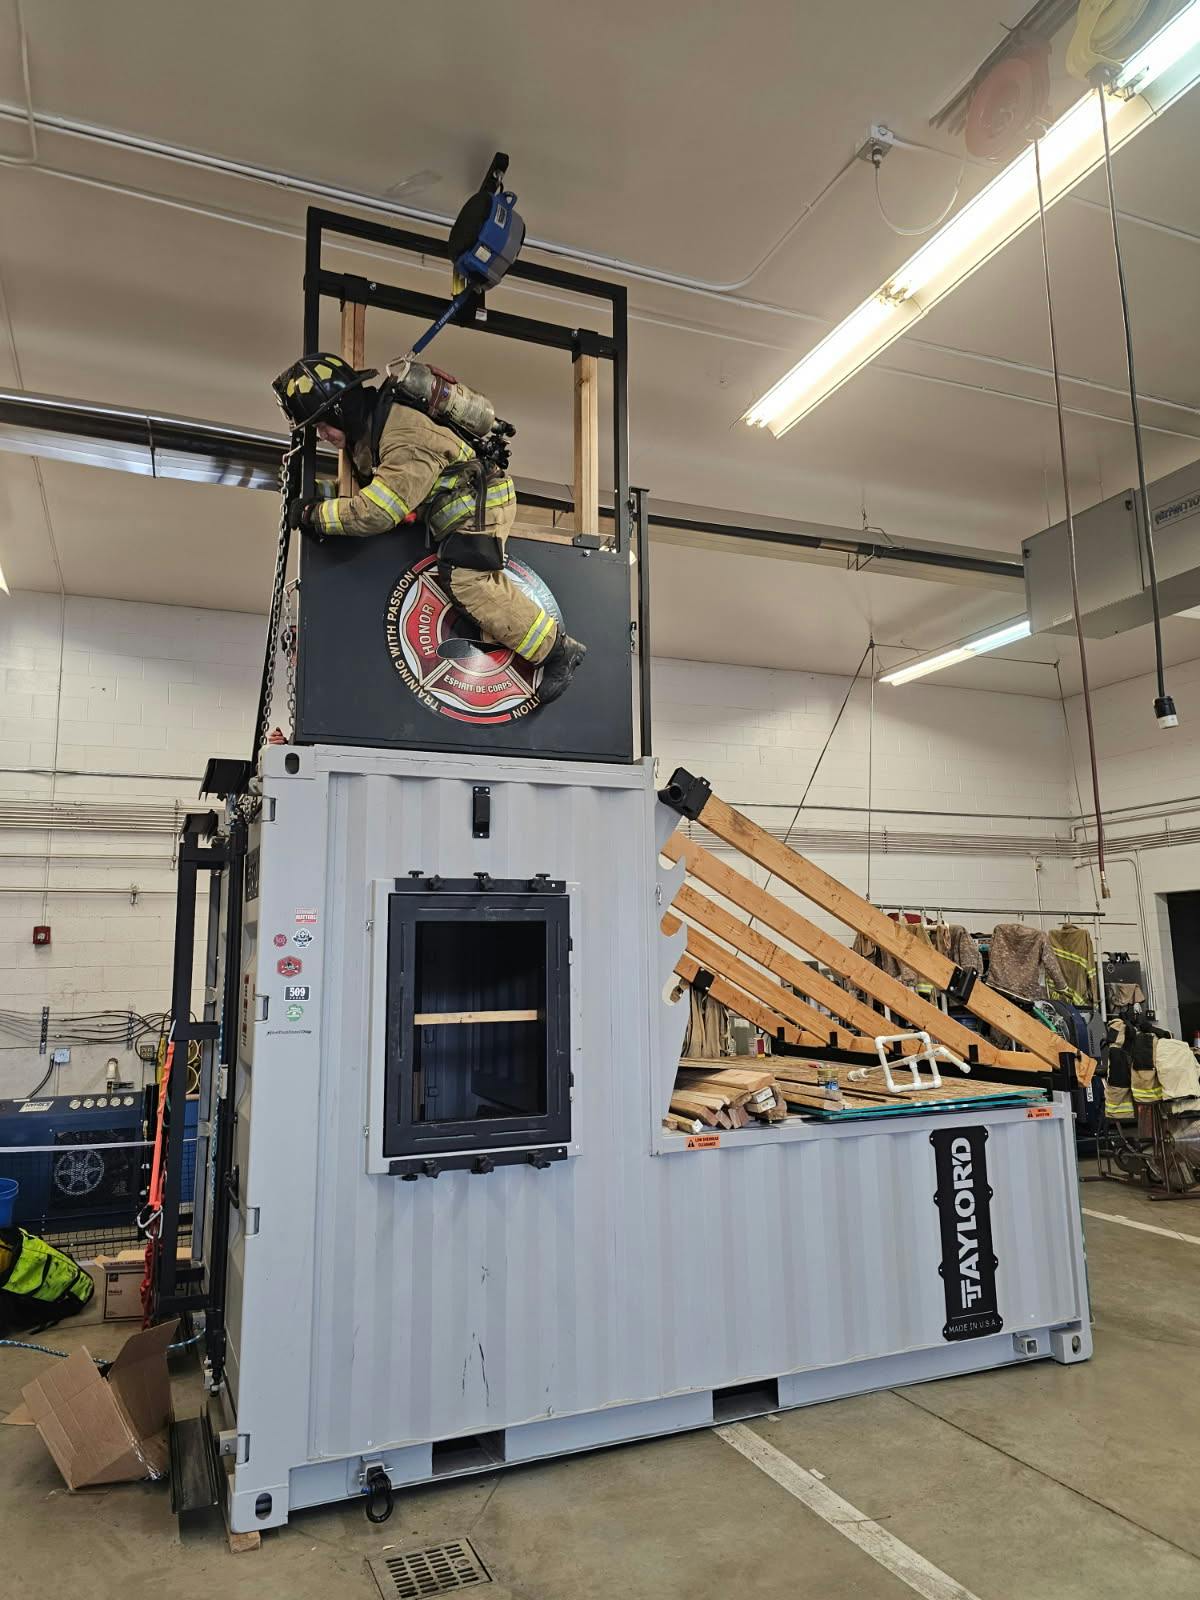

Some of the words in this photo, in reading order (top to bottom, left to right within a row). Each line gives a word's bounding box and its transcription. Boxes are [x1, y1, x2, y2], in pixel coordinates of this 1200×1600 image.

[387, 571, 415, 622] PASSION
[387, 625, 401, 658] WITH
[418, 604, 434, 656] HONOR
[395, 660, 438, 711] TRAINING
[443, 674, 473, 692] ESPIRIT
[476, 685, 486, 694] DE
[488, 680, 513, 693] CORPS
[290, 987, 306, 996] 509
[949, 1323, 968, 1333] MADE
[970, 1321, 978, 1330] IN
